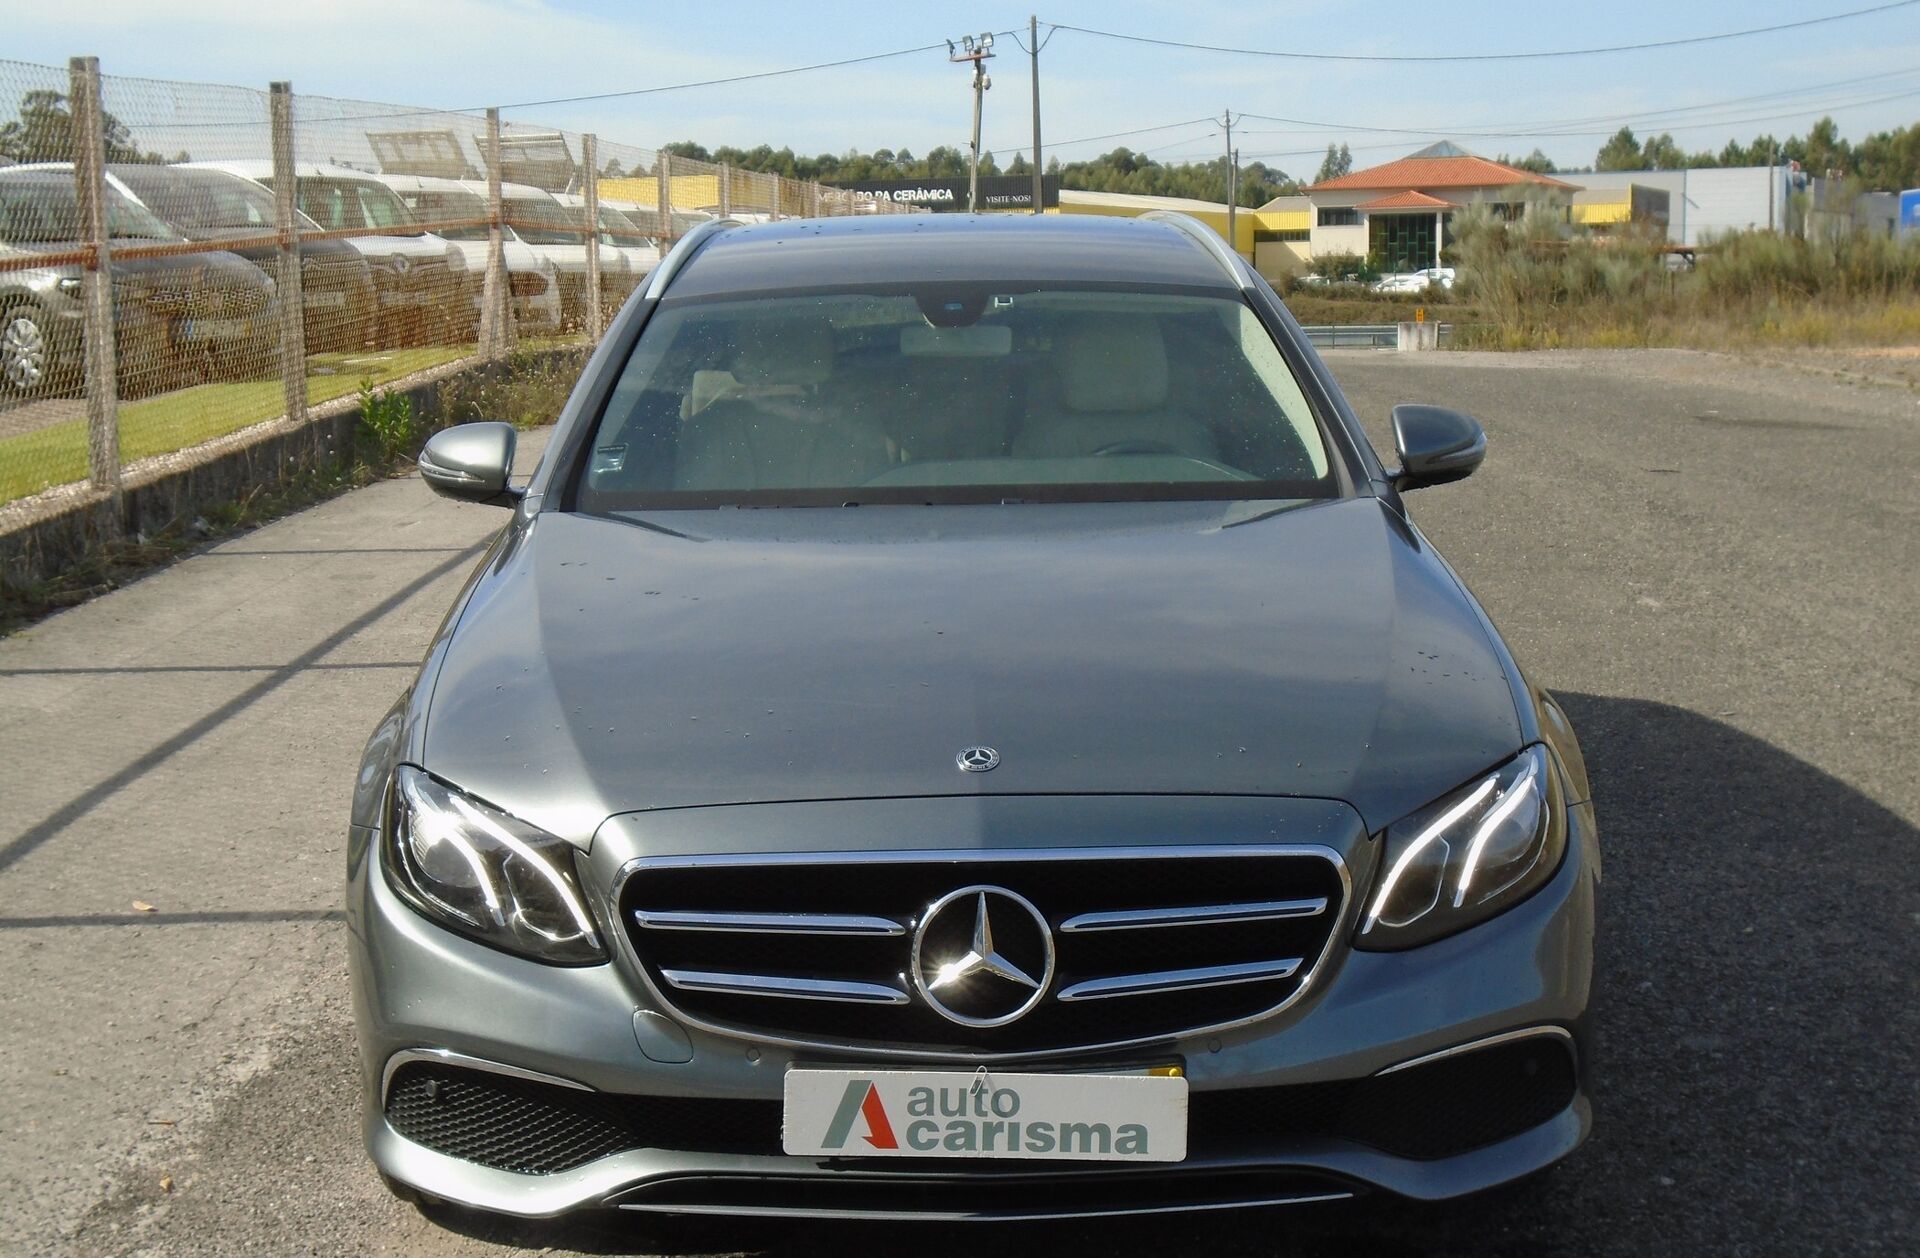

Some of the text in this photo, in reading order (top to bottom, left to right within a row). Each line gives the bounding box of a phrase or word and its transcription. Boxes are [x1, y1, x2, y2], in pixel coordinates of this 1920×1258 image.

[893, 187, 953, 201] CERÂMICA
[907, 1081, 1021, 1117] auto
[906, 1120, 1150, 1154] carisma
